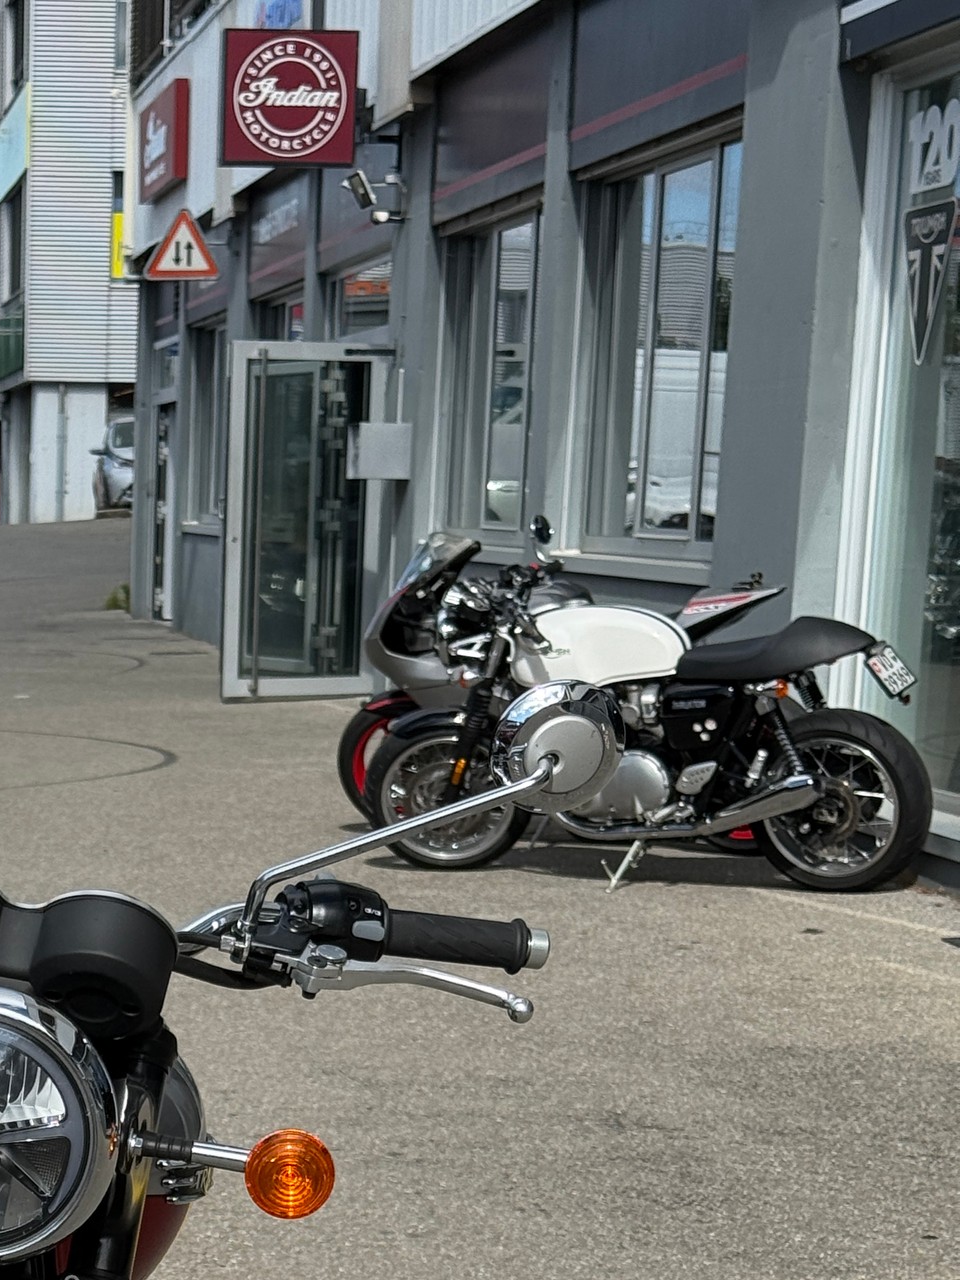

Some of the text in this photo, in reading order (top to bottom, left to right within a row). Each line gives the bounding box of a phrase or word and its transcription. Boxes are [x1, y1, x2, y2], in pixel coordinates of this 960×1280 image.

[246, 43, 336, 78] SINCE 1901
[238, 77, 340, 107] Indian
[242, 110, 337, 151] MOTORCYCLE
